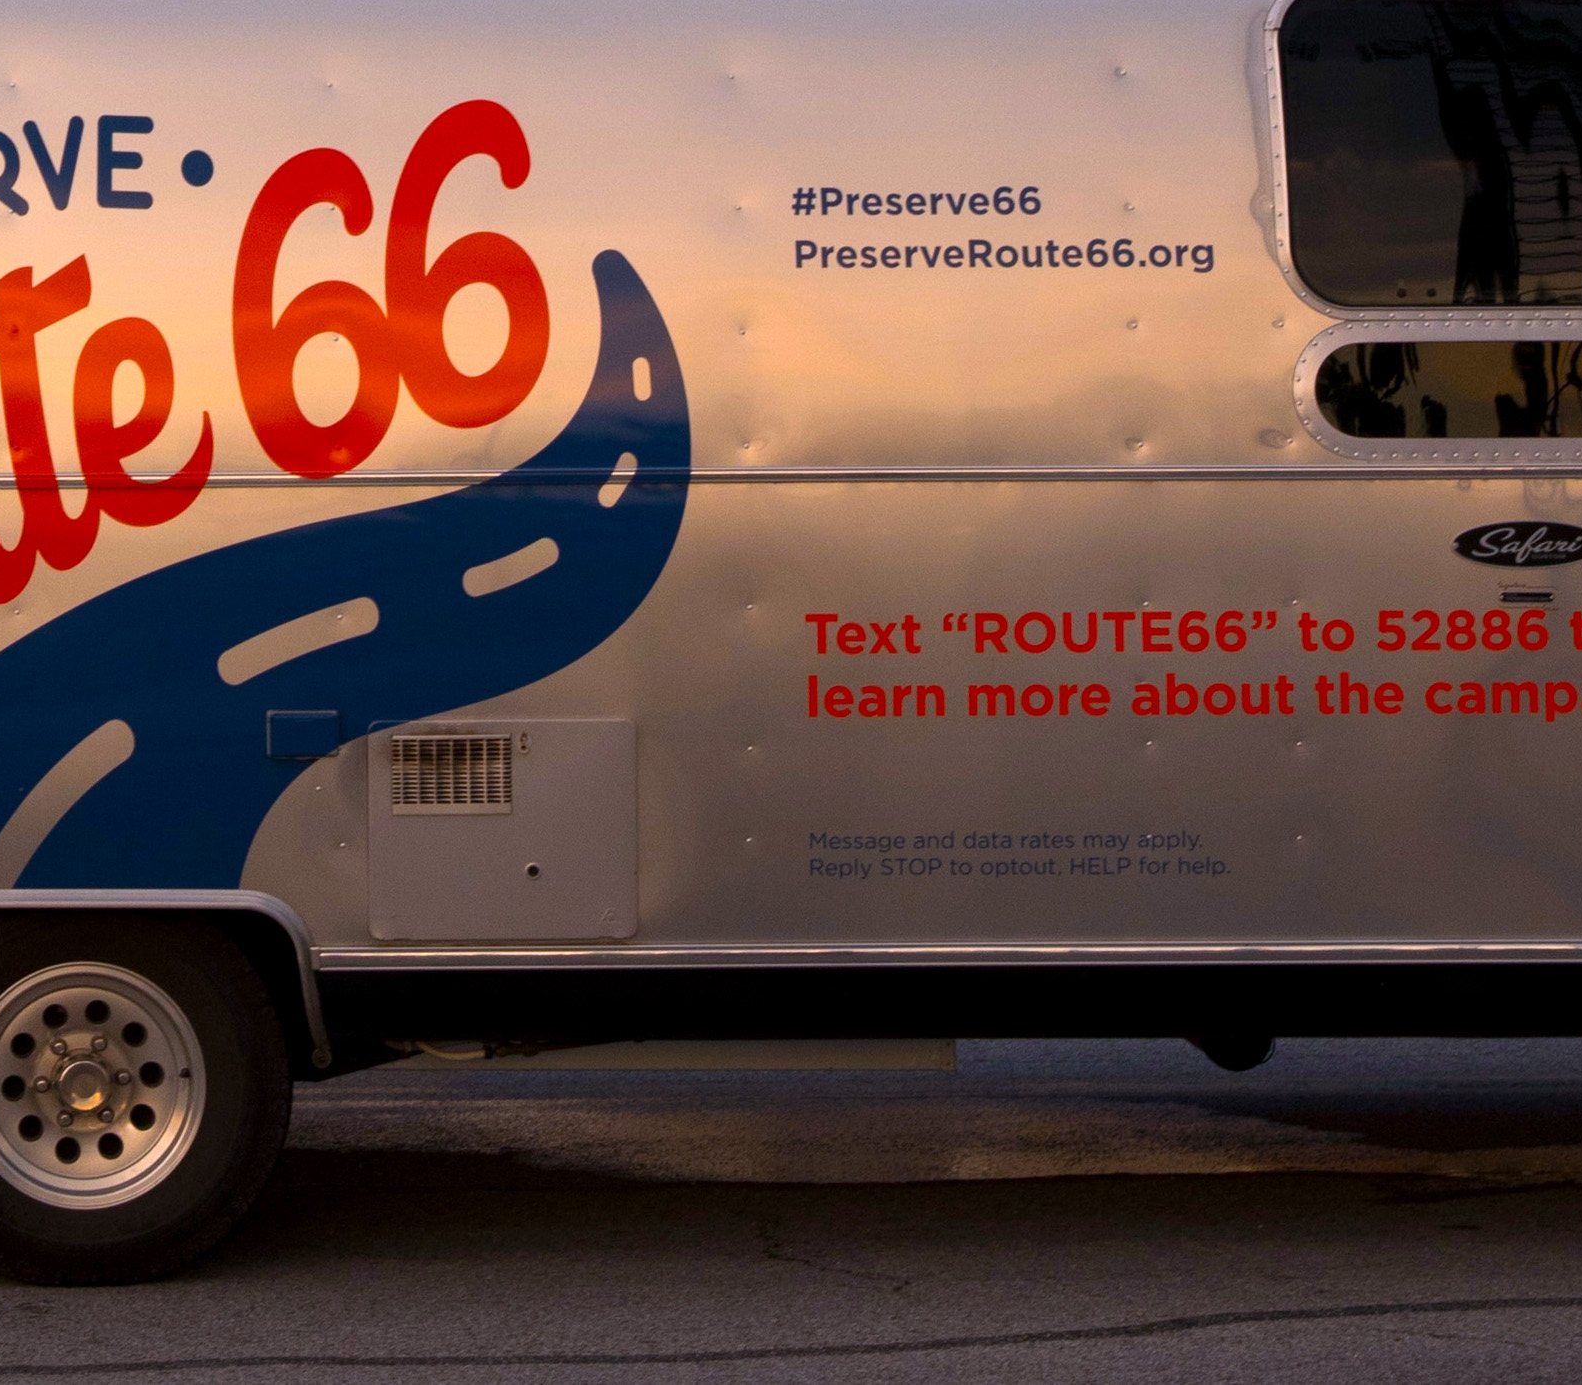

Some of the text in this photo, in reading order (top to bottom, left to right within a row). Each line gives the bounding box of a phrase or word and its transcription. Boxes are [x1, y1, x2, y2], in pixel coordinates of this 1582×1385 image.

[792, 186, 1042, 216] #Preserve66
[794, 238, 1215, 273] PreserveRoute66.org
[232, 99, 550, 480] 66
[805, 613, 922, 654] Text
[942, 610, 1278, 654] “ROUTE66”
[1298, 611, 1355, 652] to
[1377, 609, 1549, 652] 52886
[808, 674, 946, 718] learn
[968, 682, 1112, 717] more
[1131, 673, 1295, 716] about
[1315, 672, 1404, 715] the
[808, 830, 1203, 852] Message and data rates may apply.
[809, 856, 1232, 879] Reply STOP to optout, HELP for help.
